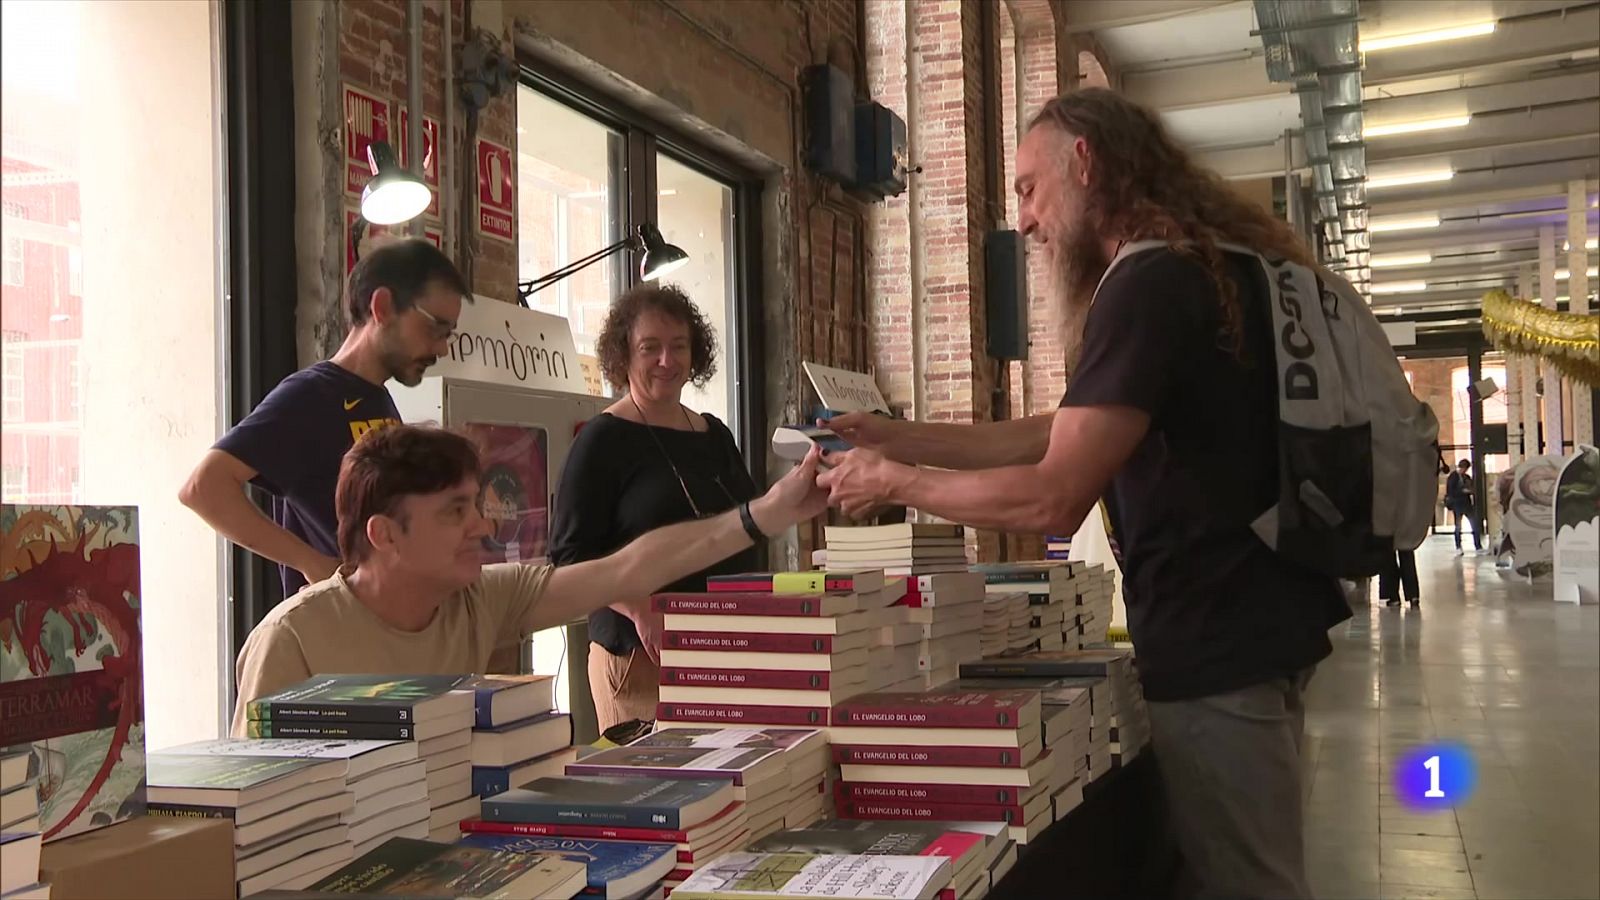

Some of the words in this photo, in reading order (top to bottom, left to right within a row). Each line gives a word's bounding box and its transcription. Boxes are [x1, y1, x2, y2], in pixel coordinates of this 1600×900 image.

[482, 212, 511, 233] EXTINTOR
[678, 601, 709, 609] EVANGELIO
[721, 602, 737, 610] LOBO
[690, 638, 720, 646] EVANGELIO
[733, 639, 748, 647] LOBO
[679, 673, 685, 681] EL
[718, 674, 729, 682] DEL
[676, 708, 682, 716] EL
[684, 709, 715, 717] EVANGELIO
[716, 709, 727, 717] DEL
[728, 710, 743, 718] LOBO
[852, 713, 860, 721] EL
[896, 714, 908, 722] DEL
[909, 714, 926, 722] LOBO
[862, 752, 897, 760] EVANGELIO
[910, 753, 928, 761] LOBO
[863, 788, 896, 796] EVANGELIO
[867, 807, 901, 815] EVANGELIO
[902, 808, 914, 816] DEL
[914, 808, 932, 817] LOBO
